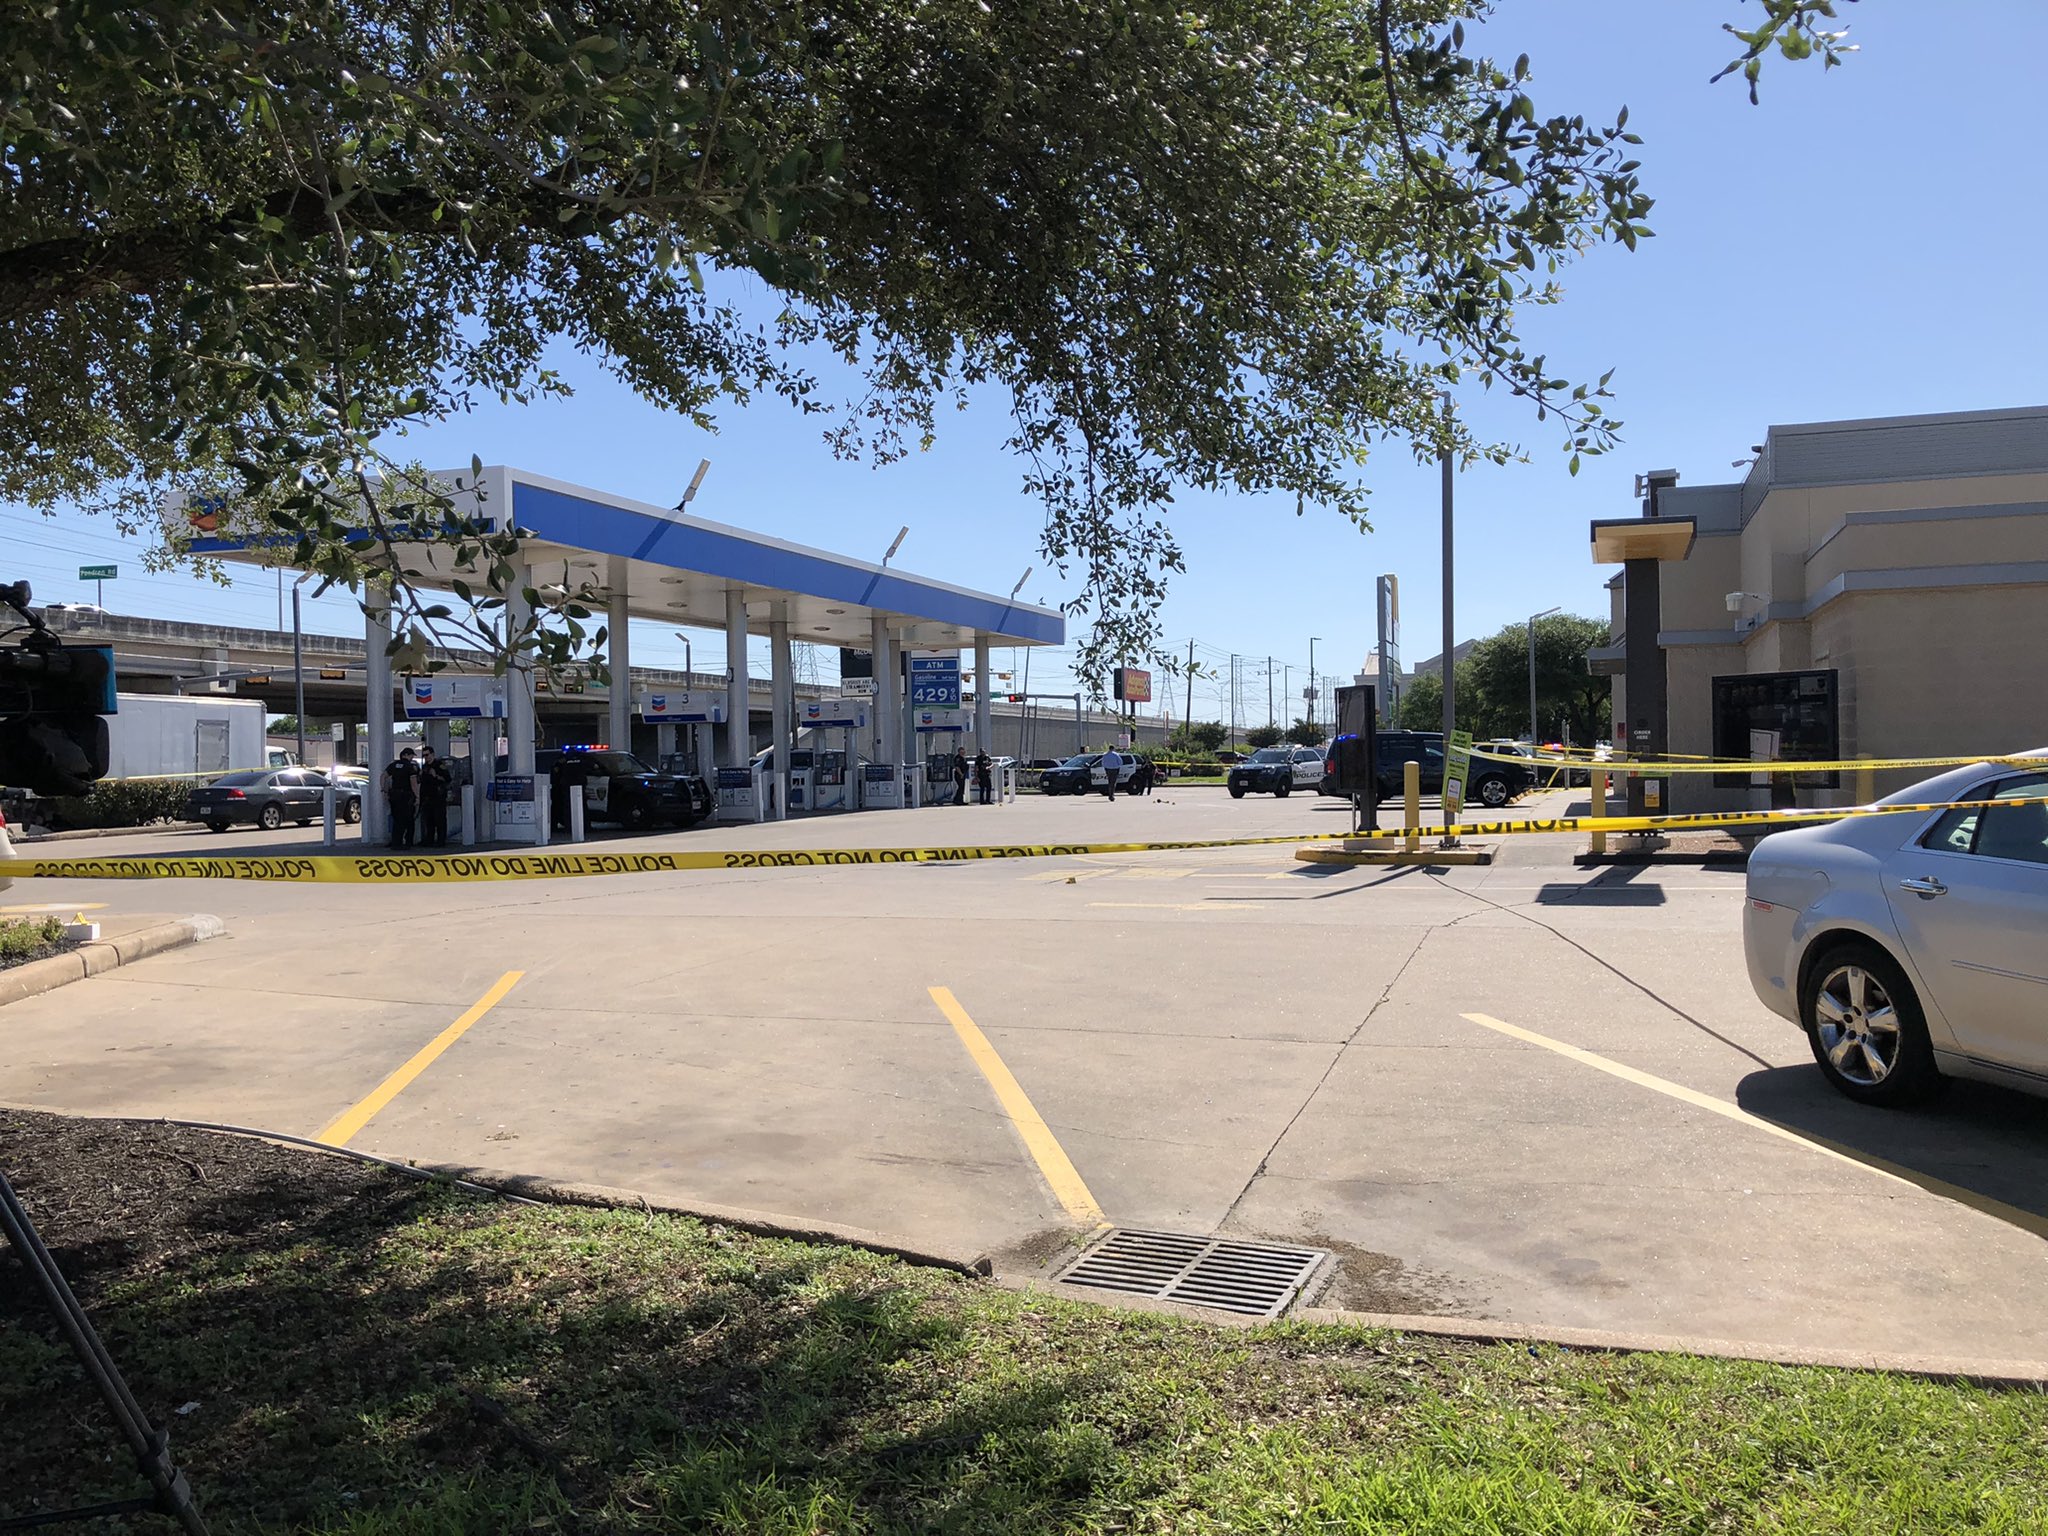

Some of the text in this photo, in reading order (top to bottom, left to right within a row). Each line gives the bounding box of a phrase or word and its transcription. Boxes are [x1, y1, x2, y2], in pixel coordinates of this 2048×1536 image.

[926, 661, 944, 669] ATM
[451, 682, 456, 694] 1
[682, 693, 690, 704] 3
[914, 688, 947, 701] 429
[833, 702, 840, 712] 5
[944, 711, 950, 719] 7
